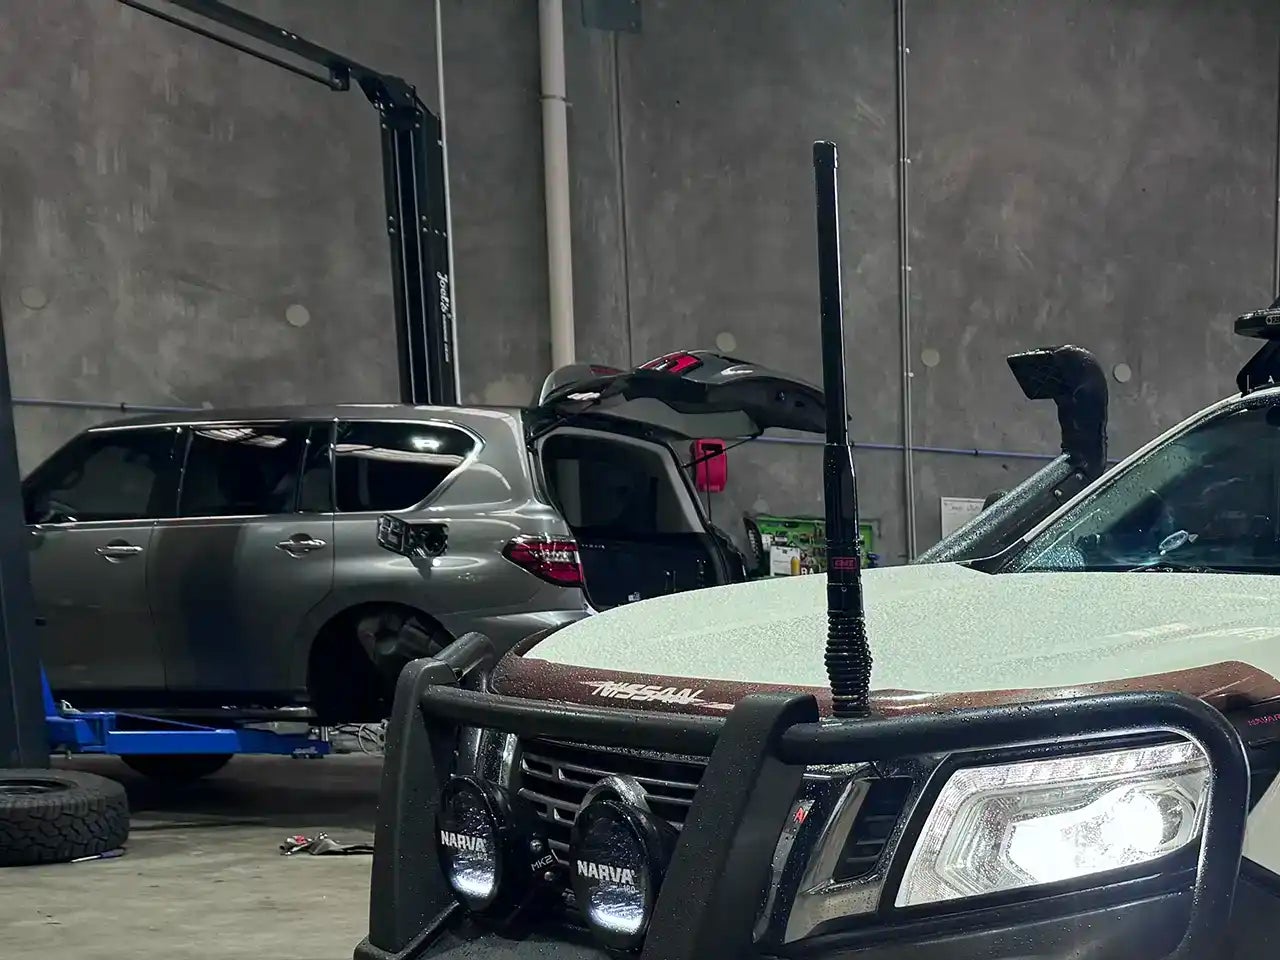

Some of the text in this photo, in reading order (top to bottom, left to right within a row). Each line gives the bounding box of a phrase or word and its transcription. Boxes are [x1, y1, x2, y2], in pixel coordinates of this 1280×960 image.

[591, 680, 705, 705] NISSAN
[440, 830, 487, 852] NARVA
[531, 854, 553, 871] MK2
[577, 860, 635, 885] NARVA
